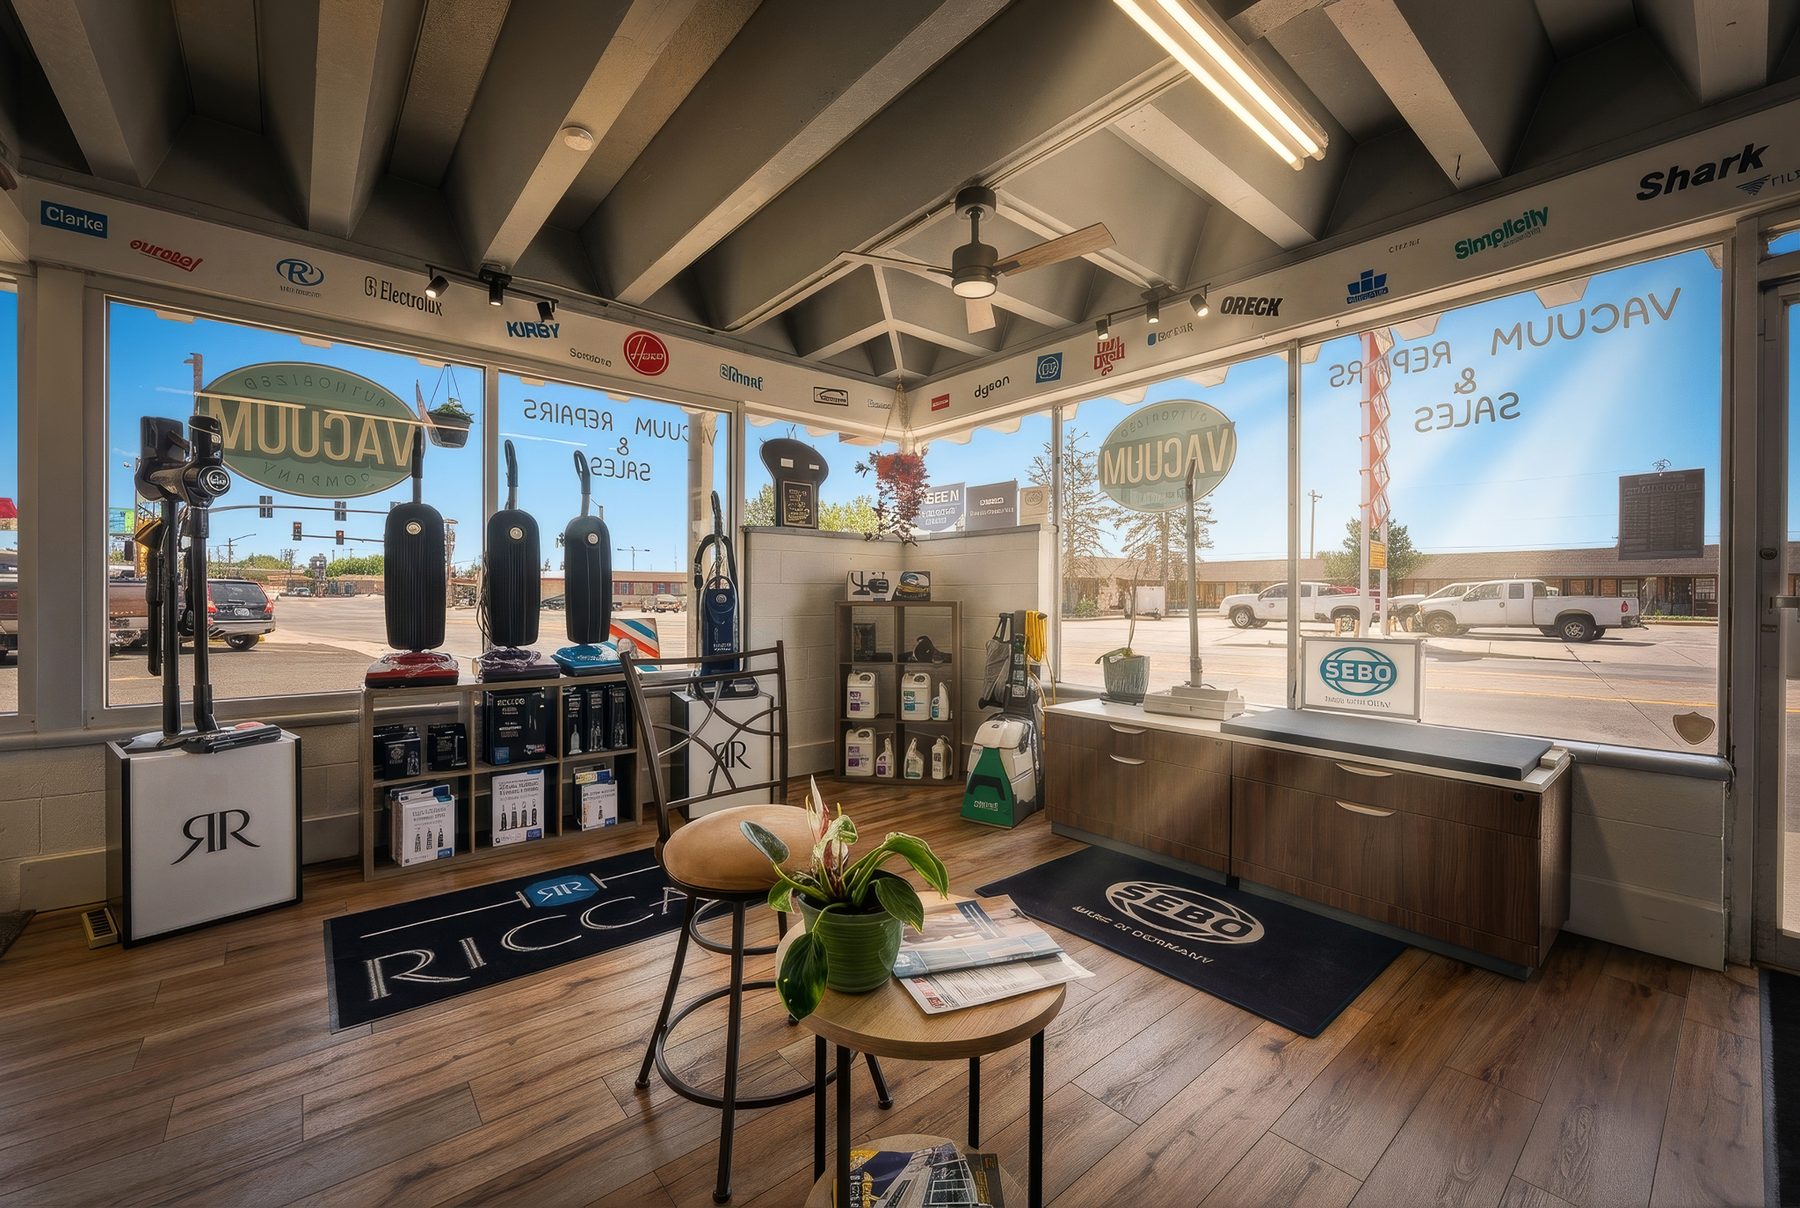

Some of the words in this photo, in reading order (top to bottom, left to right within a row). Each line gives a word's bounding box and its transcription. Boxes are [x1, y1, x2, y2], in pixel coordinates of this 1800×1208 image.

[1636, 143, 1770, 201] Shark
[380, 279, 443, 317] Electrolux
[1220, 295, 1283, 317] ORECK
[506, 320, 560, 339] KIRBY
[1325, 661, 1392, 682] SEBO
[1112, 884, 1254, 938] SEBO
